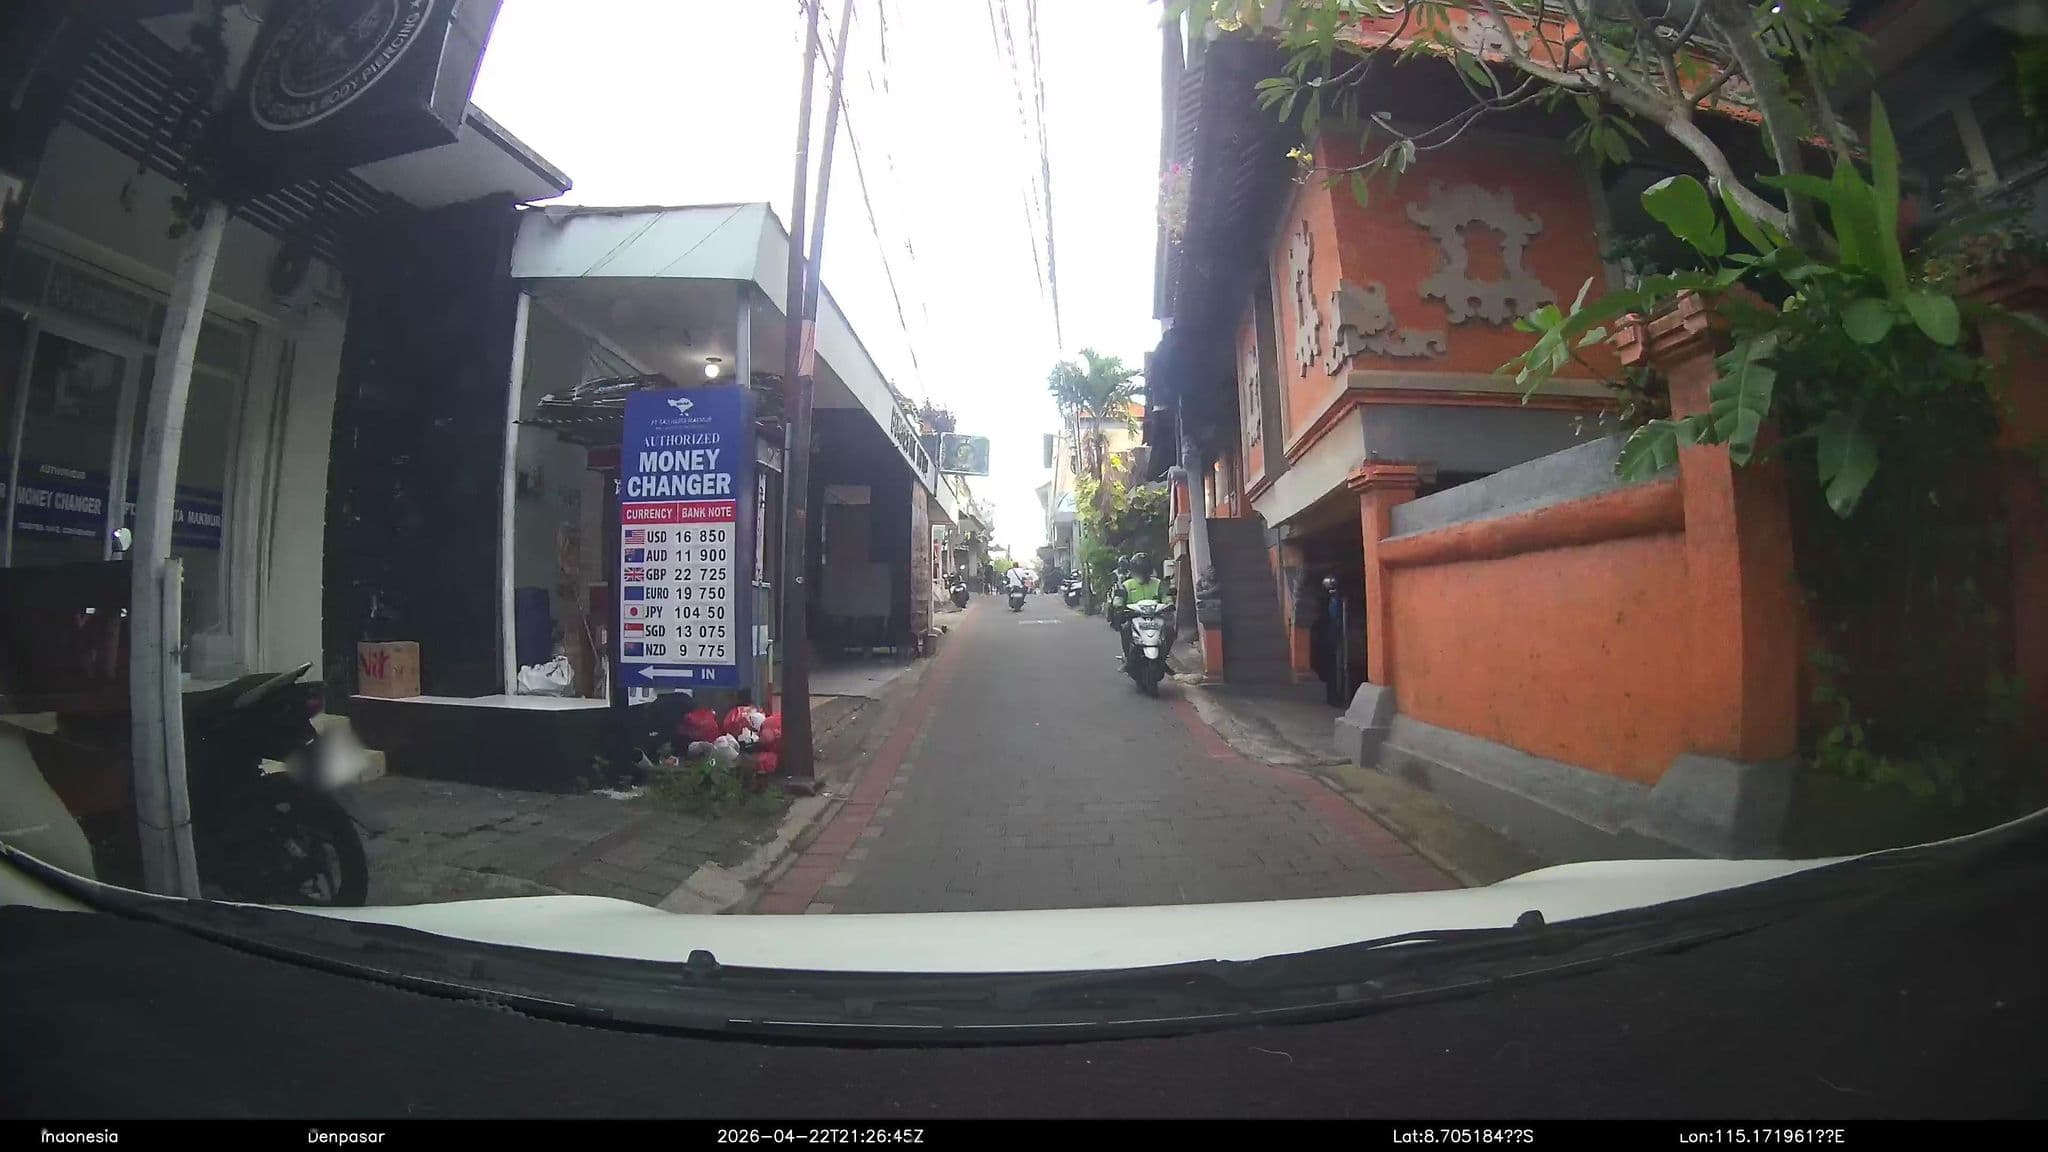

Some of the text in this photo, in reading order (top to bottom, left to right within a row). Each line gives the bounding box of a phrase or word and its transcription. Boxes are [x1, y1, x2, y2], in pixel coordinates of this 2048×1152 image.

[644, 432, 721, 448] AUTHORIZED
[639, 448, 721, 473] MONEY
[627, 472, 731, 497] CHANGER
[16, 486, 54, 509] MONEY
[54, 491, 102, 515] CHANGER
[626, 508, 673, 520] CURRENCY
[681, 506, 732, 518] BANK NOTE
[647, 529, 726, 543] USD 16 850
[646, 548, 726, 562] AUD 11 900
[646, 567, 726, 581] GBP 22 725
[645, 586, 726, 600] EURO 19 750
[644, 605, 725, 619] JPY 104 50
[645, 624, 726, 638] SGD 13 075
[645, 644, 725, 657] NZD 9 775
[701, 668, 716, 680] IN
